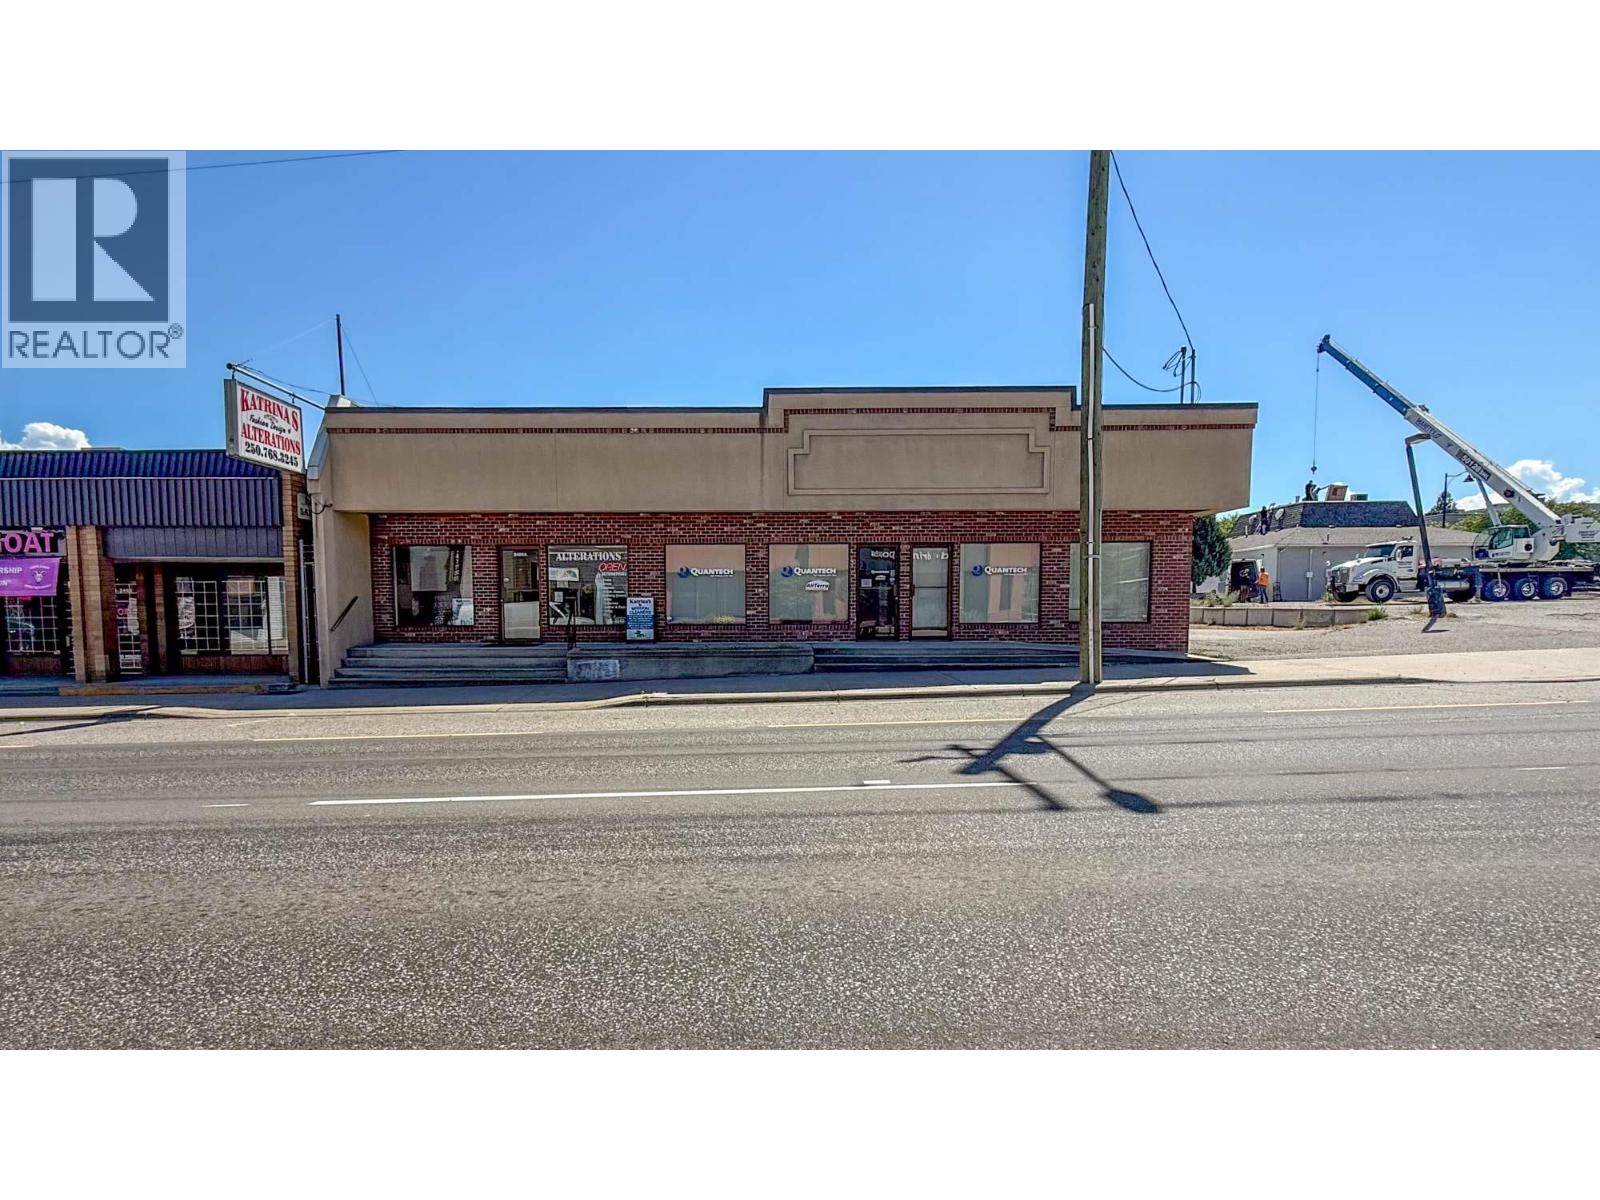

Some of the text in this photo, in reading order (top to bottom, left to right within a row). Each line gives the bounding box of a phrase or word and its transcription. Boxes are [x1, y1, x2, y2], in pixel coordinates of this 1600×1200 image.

[241, 388, 299, 432] KATRINAS
[241, 422, 301, 456] ALTERATIONS
[245, 441, 299, 467] 250.768.3245
[0, 531, 54, 553] OAT
[555, 551, 622, 561] ALTERATIONS
[599, 563, 628, 572] OPEN
[690, 567, 734, 577] QUANTECH
[794, 567, 837, 576] QUANTECH
[984, 566, 1027, 575] QUANTECH
